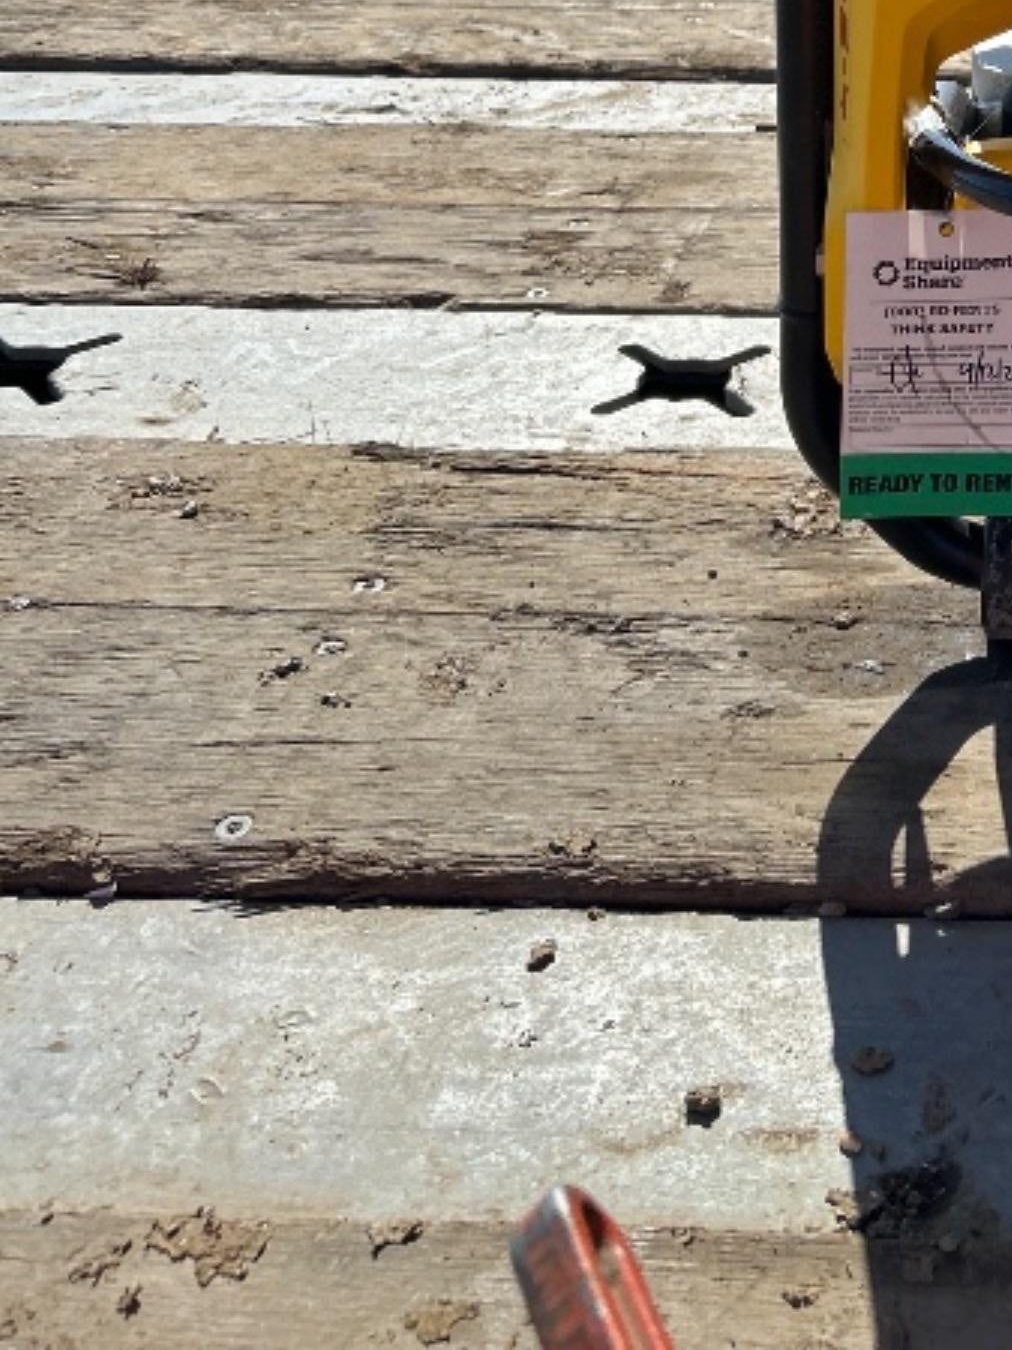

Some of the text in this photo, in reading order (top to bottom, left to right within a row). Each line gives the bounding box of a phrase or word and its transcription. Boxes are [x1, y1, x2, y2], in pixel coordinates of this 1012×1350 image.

[903, 275, 963, 290] Share
[849, 474, 923, 496] READY
[929, 474, 957, 495] TO
